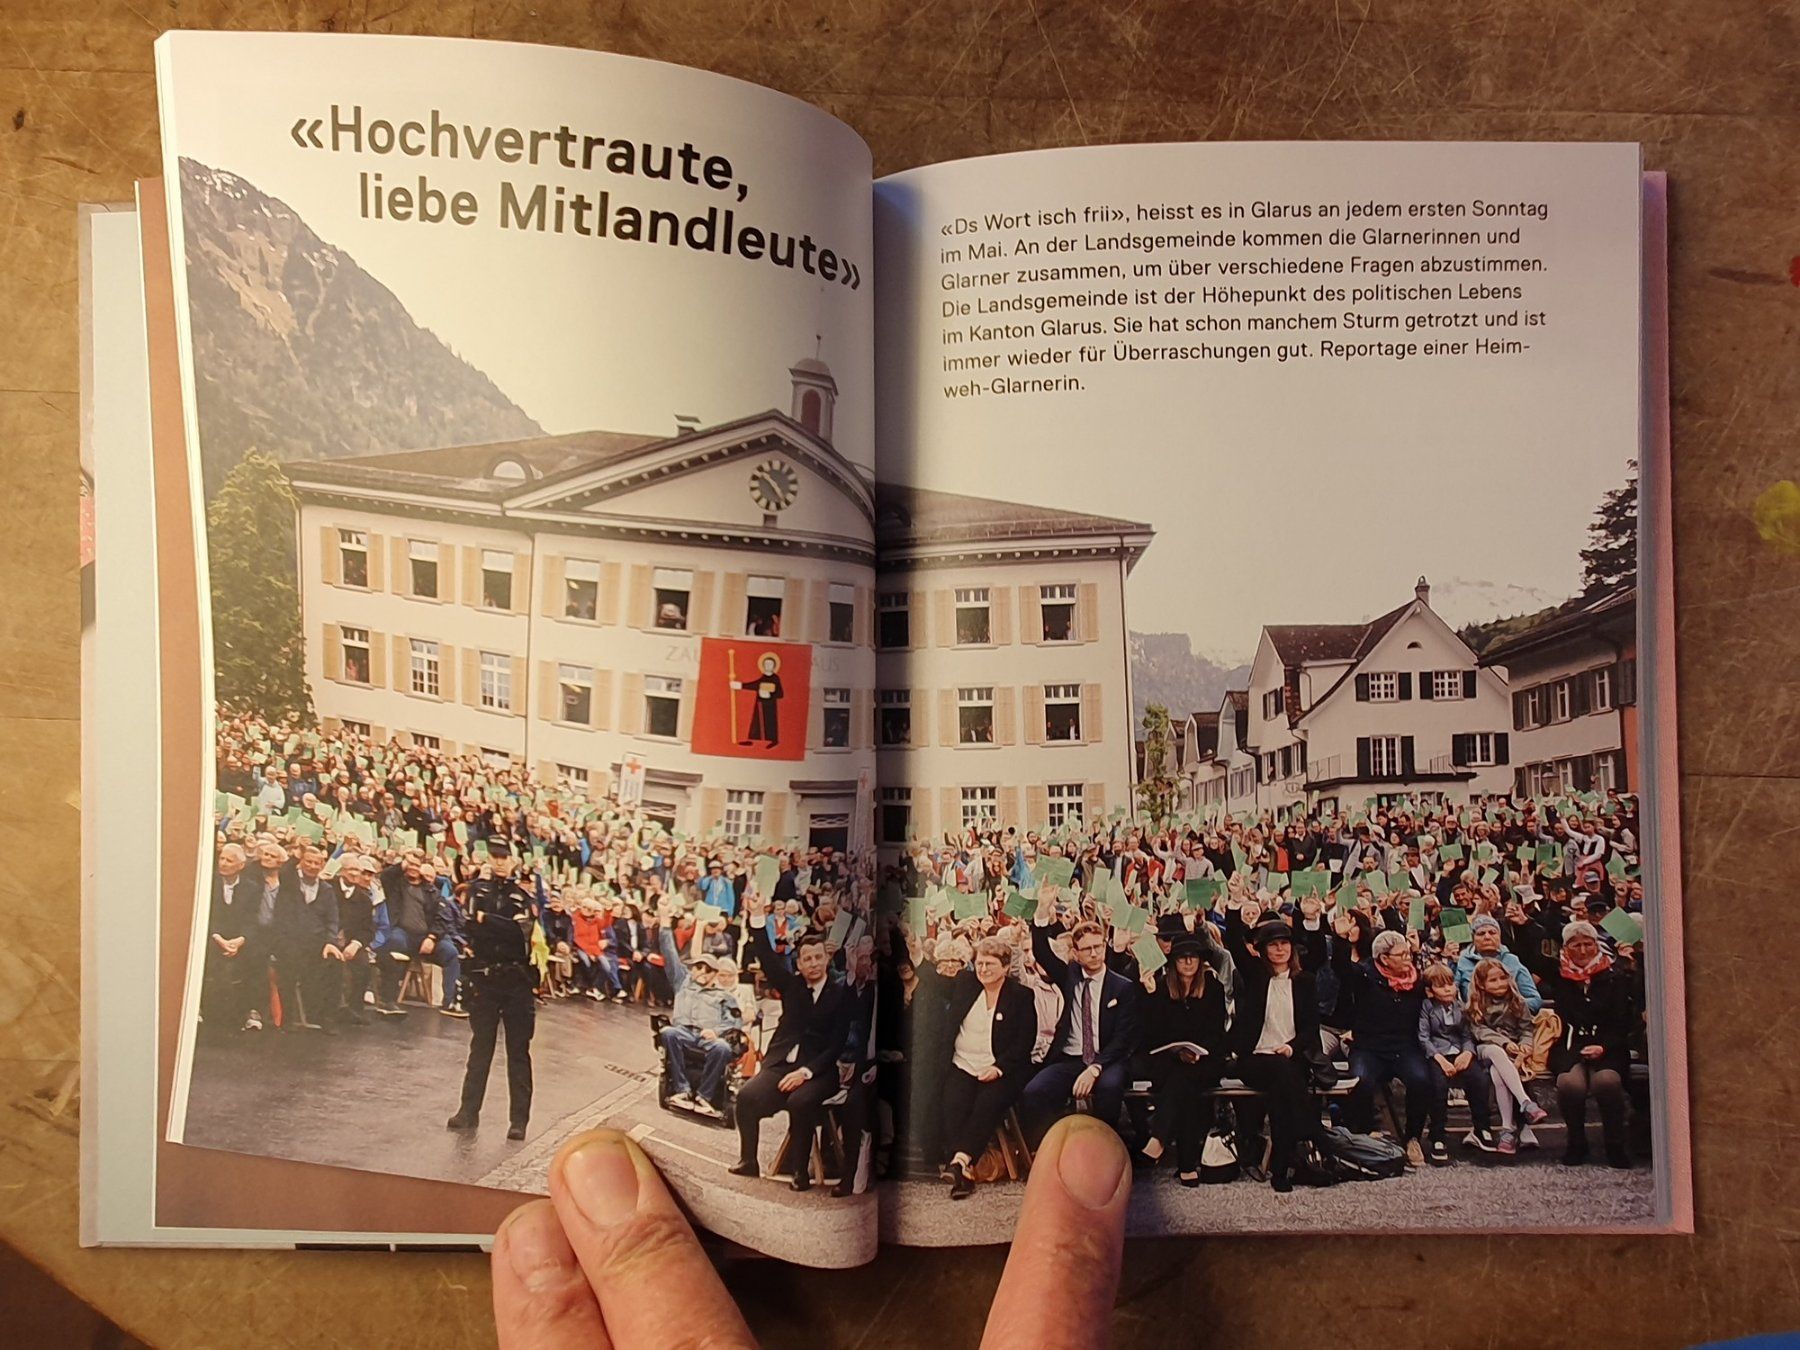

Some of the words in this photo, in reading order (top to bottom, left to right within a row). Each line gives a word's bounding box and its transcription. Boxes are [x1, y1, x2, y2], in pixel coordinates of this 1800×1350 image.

[290, 104, 748, 203] «Hochvertraute,
[359, 172, 479, 226] liebe
[500, 181, 861, 291] Mitlandleute»
[941, 218, 978, 236] «Ds
[983, 212, 1032, 232] Wort
[1038, 207, 1077, 226] isch
[1083, 205, 1130, 224] frii»,
[1136, 203, 1195, 221] heisst
[1200, 206, 1222, 220] es
[1228, 201, 1245, 219] in
[1251, 200, 1312, 219] Glarus
[1318, 204, 1340, 218] an
[1344, 199, 1402, 222] jedem
[1407, 201, 1466, 218] ersten
[1471, 199, 1548, 221] Sonntag
[941, 248, 962, 264] im
[968, 241, 1008, 261] Mai.
[1014, 238, 1040, 256] An
[1046, 235, 1078, 254] der
[1085, 229, 1236, 254] Landsgemeinde
[1242, 229, 1323, 247] kommen
[1328, 228, 1357, 246] die
[1362, 227, 1481, 246] Glarnerinnen
[1486, 227, 1520, 245] und
[941, 271, 1011, 291] Glarner
[1017, 265, 1126, 284] zusammen,
[1133, 263, 1162, 278] um
[1168, 258, 1212, 277] über
[1217, 256, 1344, 275] verschiedene
[1350, 255, 1415, 278] Fragen
[1420, 255, 1548, 273] abzustimmen.
[942, 301, 971, 318] Die
[977, 288, 1128, 314] Landsgemeinde
[1134, 288, 1158, 305] ist
[1163, 286, 1196, 305] der
[1202, 284, 1307, 307] Höhepunkt
[1312, 284, 1346, 302] des
[1352, 283, 1452, 306] politischen
[1458, 282, 1522, 300] Lebens
[942, 329, 963, 345] im
[969, 324, 1035, 342] Kanton
[1040, 318, 1107, 337] Glarus.
[1113, 316, 1143, 334] Sie
[1149, 315, 1180, 333] hat
[1185, 314, 1241, 332] schon
[1247, 312, 1337, 331] manchem
[1342, 311, 1399, 330] Sturm
[1404, 312, 1479, 333] getrotzt
[1484, 309, 1518, 327] und
[1524, 309, 1546, 327] ist
[943, 352, 1001, 372] immer
[1007, 347, 1072, 367] wieder
[1078, 345, 1107, 363] für
[1113, 340, 1271, 363] Überraschungen
[1276, 342, 1314, 363] gut.
[1320, 340, 1418, 362] Reportage
[1423, 338, 1470, 356] einer
[1475, 337, 1530, 355] Heim-
[943, 374, 1085, 398] weh-Glarnerin.
